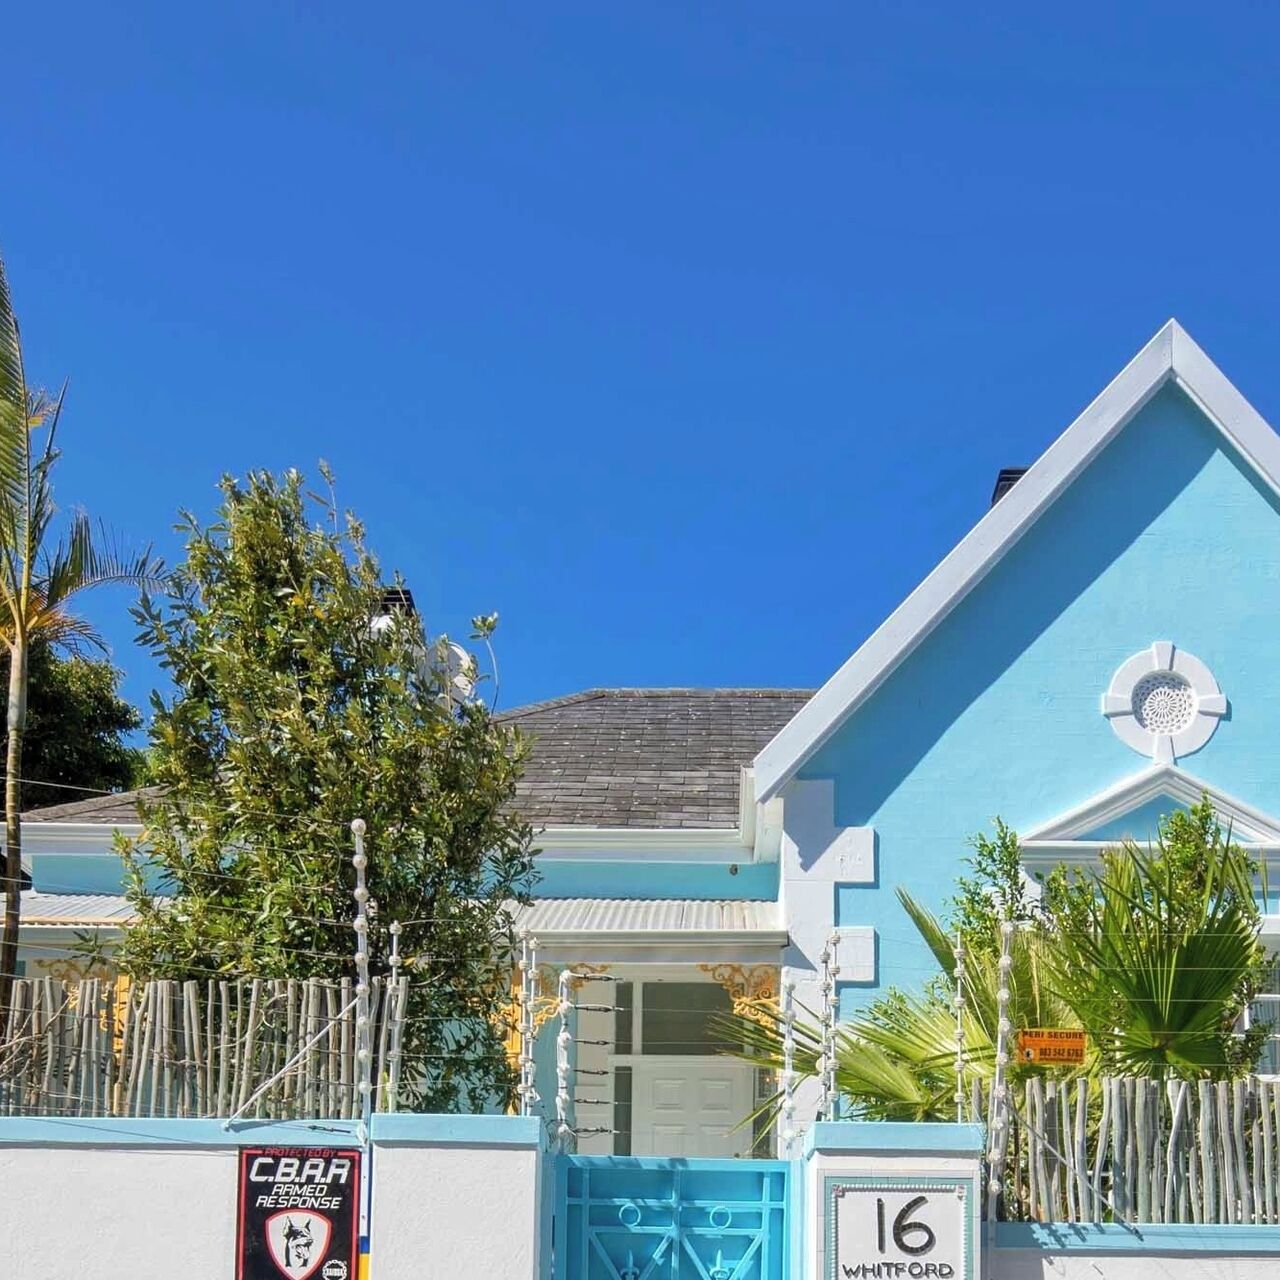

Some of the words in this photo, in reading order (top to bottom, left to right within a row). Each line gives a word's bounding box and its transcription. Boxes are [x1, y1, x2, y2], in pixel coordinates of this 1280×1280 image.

[1047, 1031, 1084, 1040] SECURE
[264, 1147, 321, 1157] PROTECTED
[321, 1149, 336, 1158] BY
[271, 1183, 327, 1198] ARMED
[255, 1195, 343, 1210] RESPONSE
[876, 1195, 935, 1256] 16
[841, 1262, 955, 1280] WHITFORD
